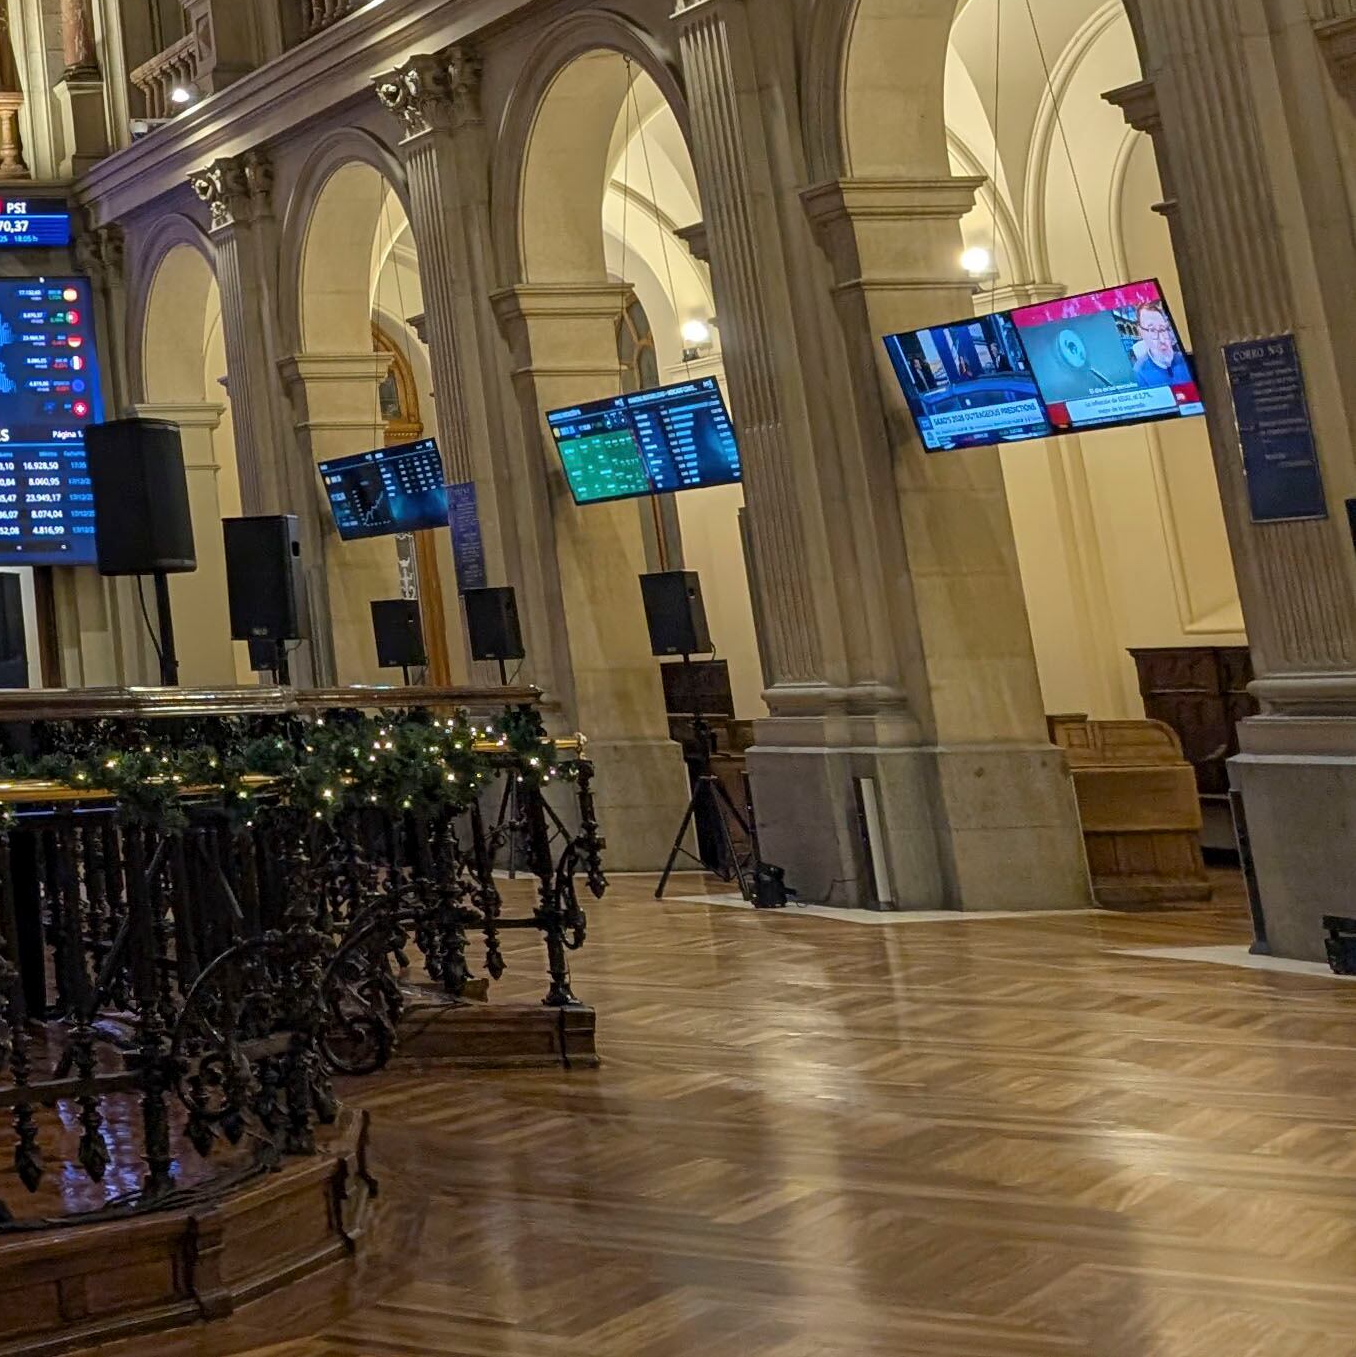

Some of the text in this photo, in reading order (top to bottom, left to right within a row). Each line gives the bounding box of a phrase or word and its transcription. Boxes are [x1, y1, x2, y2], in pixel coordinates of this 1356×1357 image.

[7, 202, 26, 213] PSI
[52, 430, 75, 440] Página
[23, 461, 59, 471] 16.928,50
